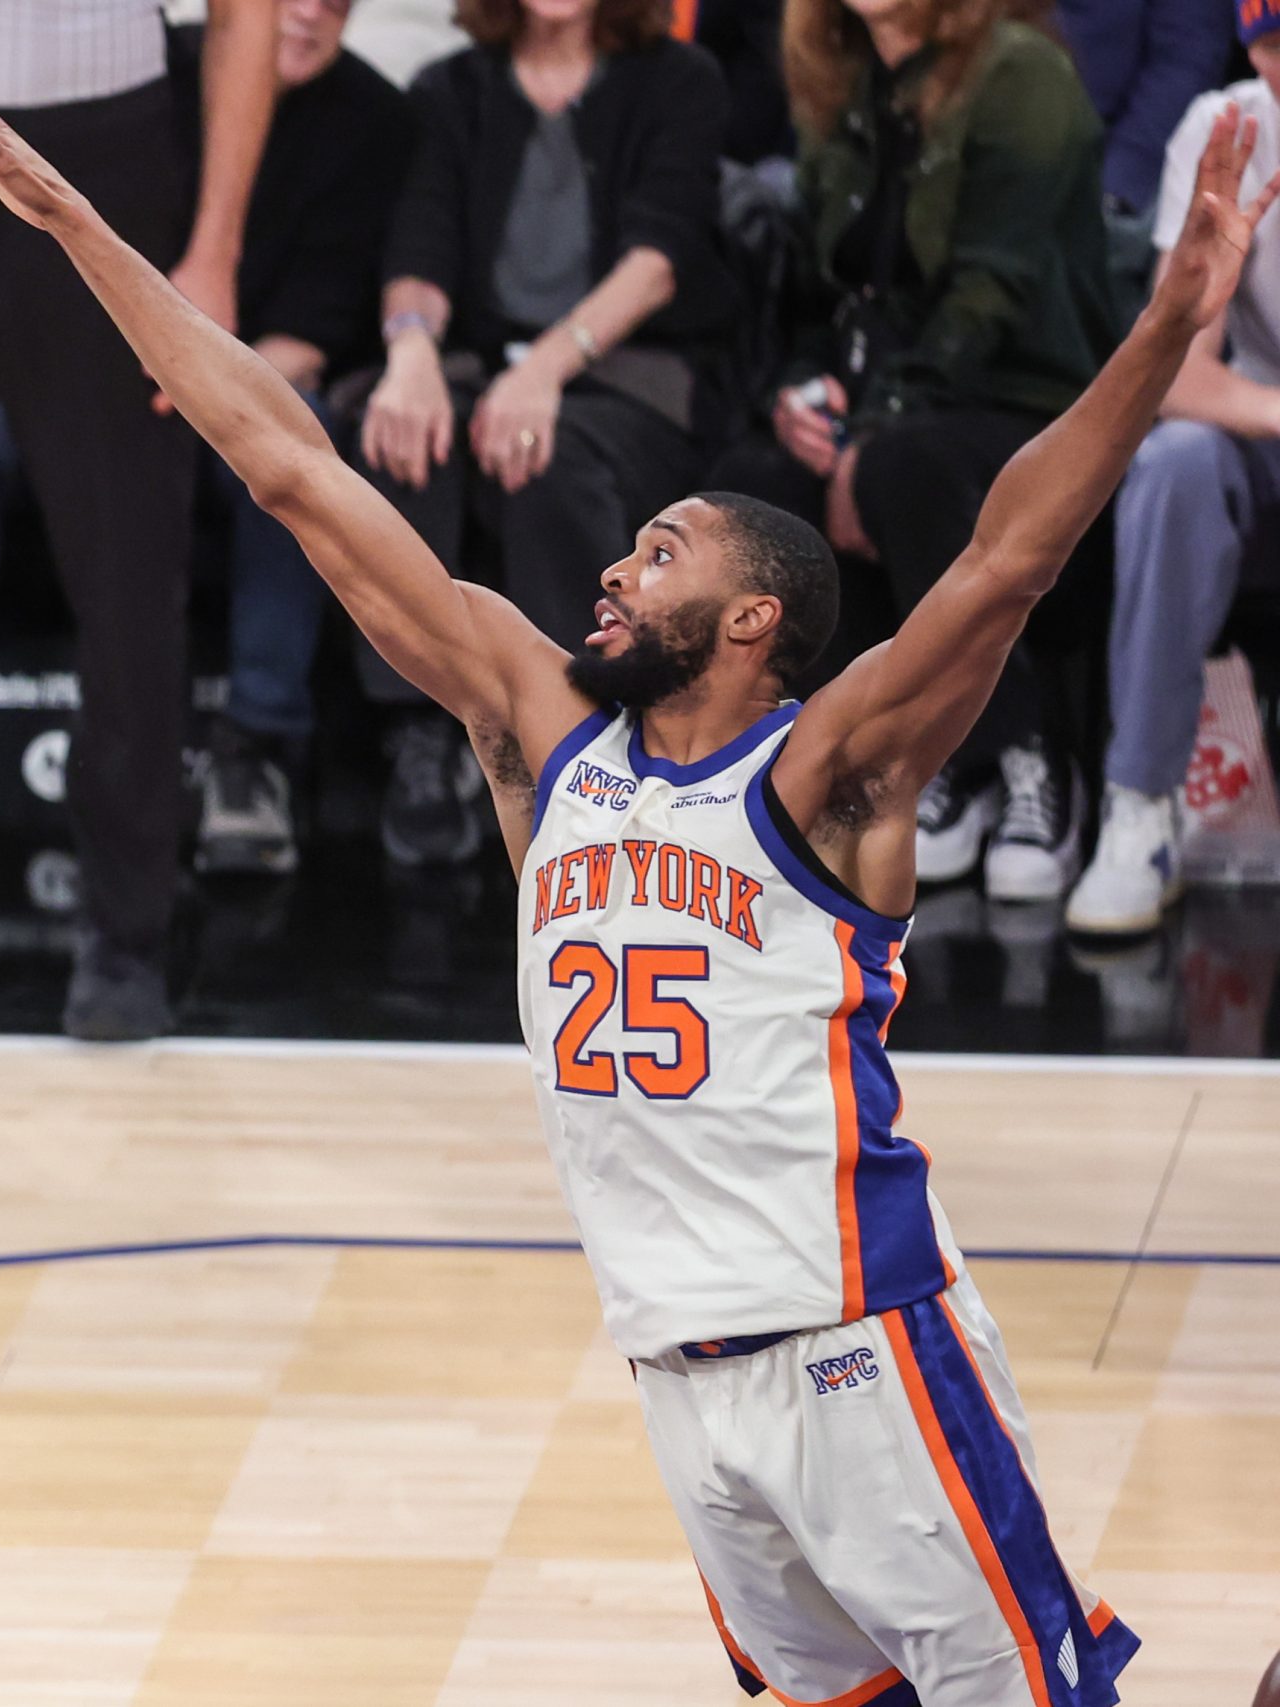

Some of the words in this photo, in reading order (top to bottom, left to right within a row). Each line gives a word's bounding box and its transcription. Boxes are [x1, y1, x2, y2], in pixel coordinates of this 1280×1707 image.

[567, 761, 637, 810] NYC
[532, 843, 616, 935] NEW
[622, 840, 763, 952] YORK
[549, 940, 710, 1100] 25
[806, 1348, 879, 1395] NYC
